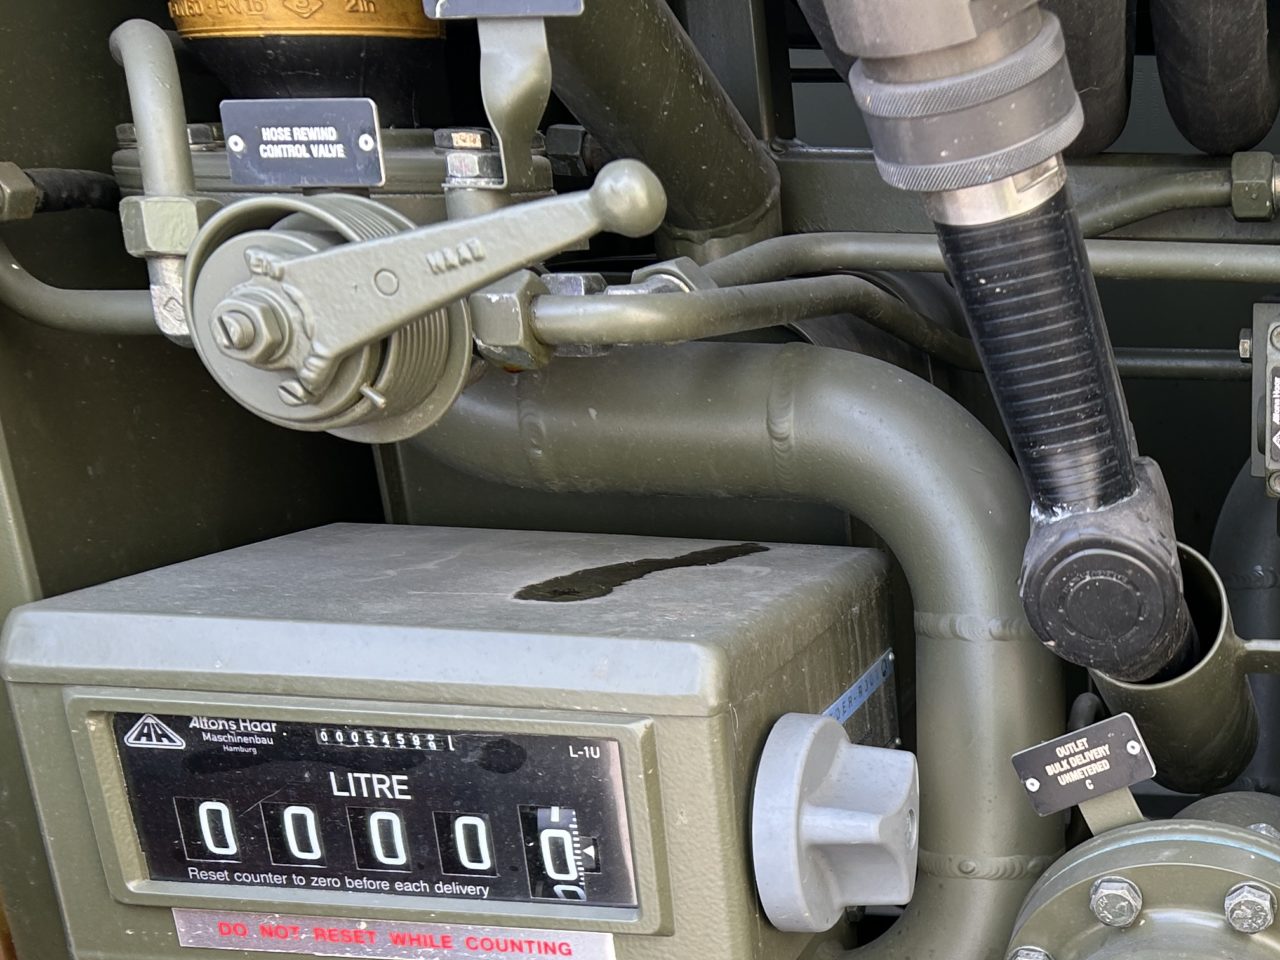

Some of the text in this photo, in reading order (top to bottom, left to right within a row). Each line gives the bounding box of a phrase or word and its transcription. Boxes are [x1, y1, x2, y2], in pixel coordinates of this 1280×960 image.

[261, 126, 337, 141] HOSE REWIND
[259, 143, 347, 158] CONTROL VALVE
[189, 717, 277, 733] Alfons Haar
[202, 732, 274, 745] Maschinenbau
[1055, 737, 1089, 758] OUTLET
[223, 744, 258, 755] Hamburg
[569, 745, 600, 759] L-1U
[1045, 744, 1111, 776] BULK DELIVERY
[1057, 759, 1110, 786] UNMETERED
[329, 771, 412, 800] LITRE
[1085, 779, 1095, 790] C
[199, 800, 579, 881] 0 0 0 0 0
[188, 866, 490, 898] Reset counter to zero before each delivery
[217, 921, 573, 957] DO NOT RESET WHILE COUNTING
